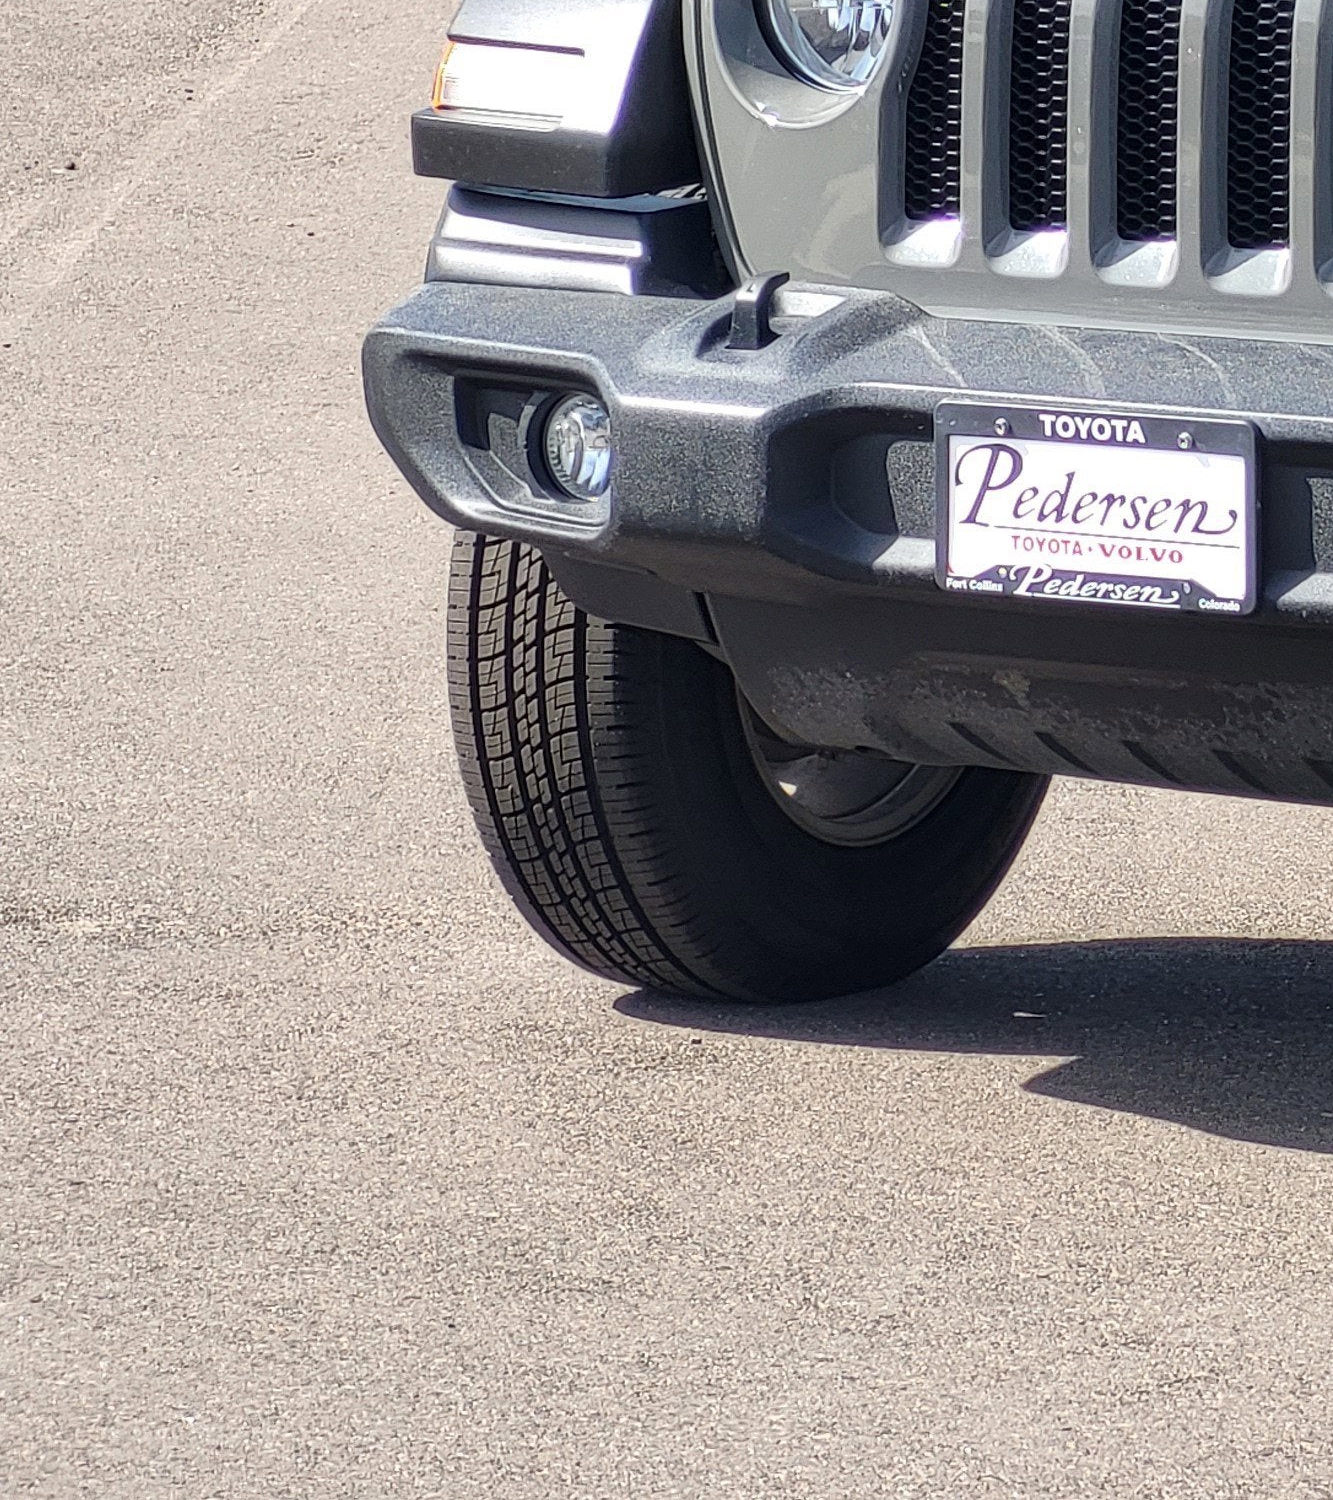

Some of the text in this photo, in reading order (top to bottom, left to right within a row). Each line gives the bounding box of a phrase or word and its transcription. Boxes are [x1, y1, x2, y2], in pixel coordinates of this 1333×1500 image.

[1038, 414, 1146, 444] TOYOTA
[955, 443, 1238, 535] Pedersen
[1011, 535, 1184, 564] TOYOTA VOLVO
[945, 578, 1003, 592] Fort Collins
[1009, 563, 1180, 604] Pedersen
[1198, 598, 1241, 612] Colorado
